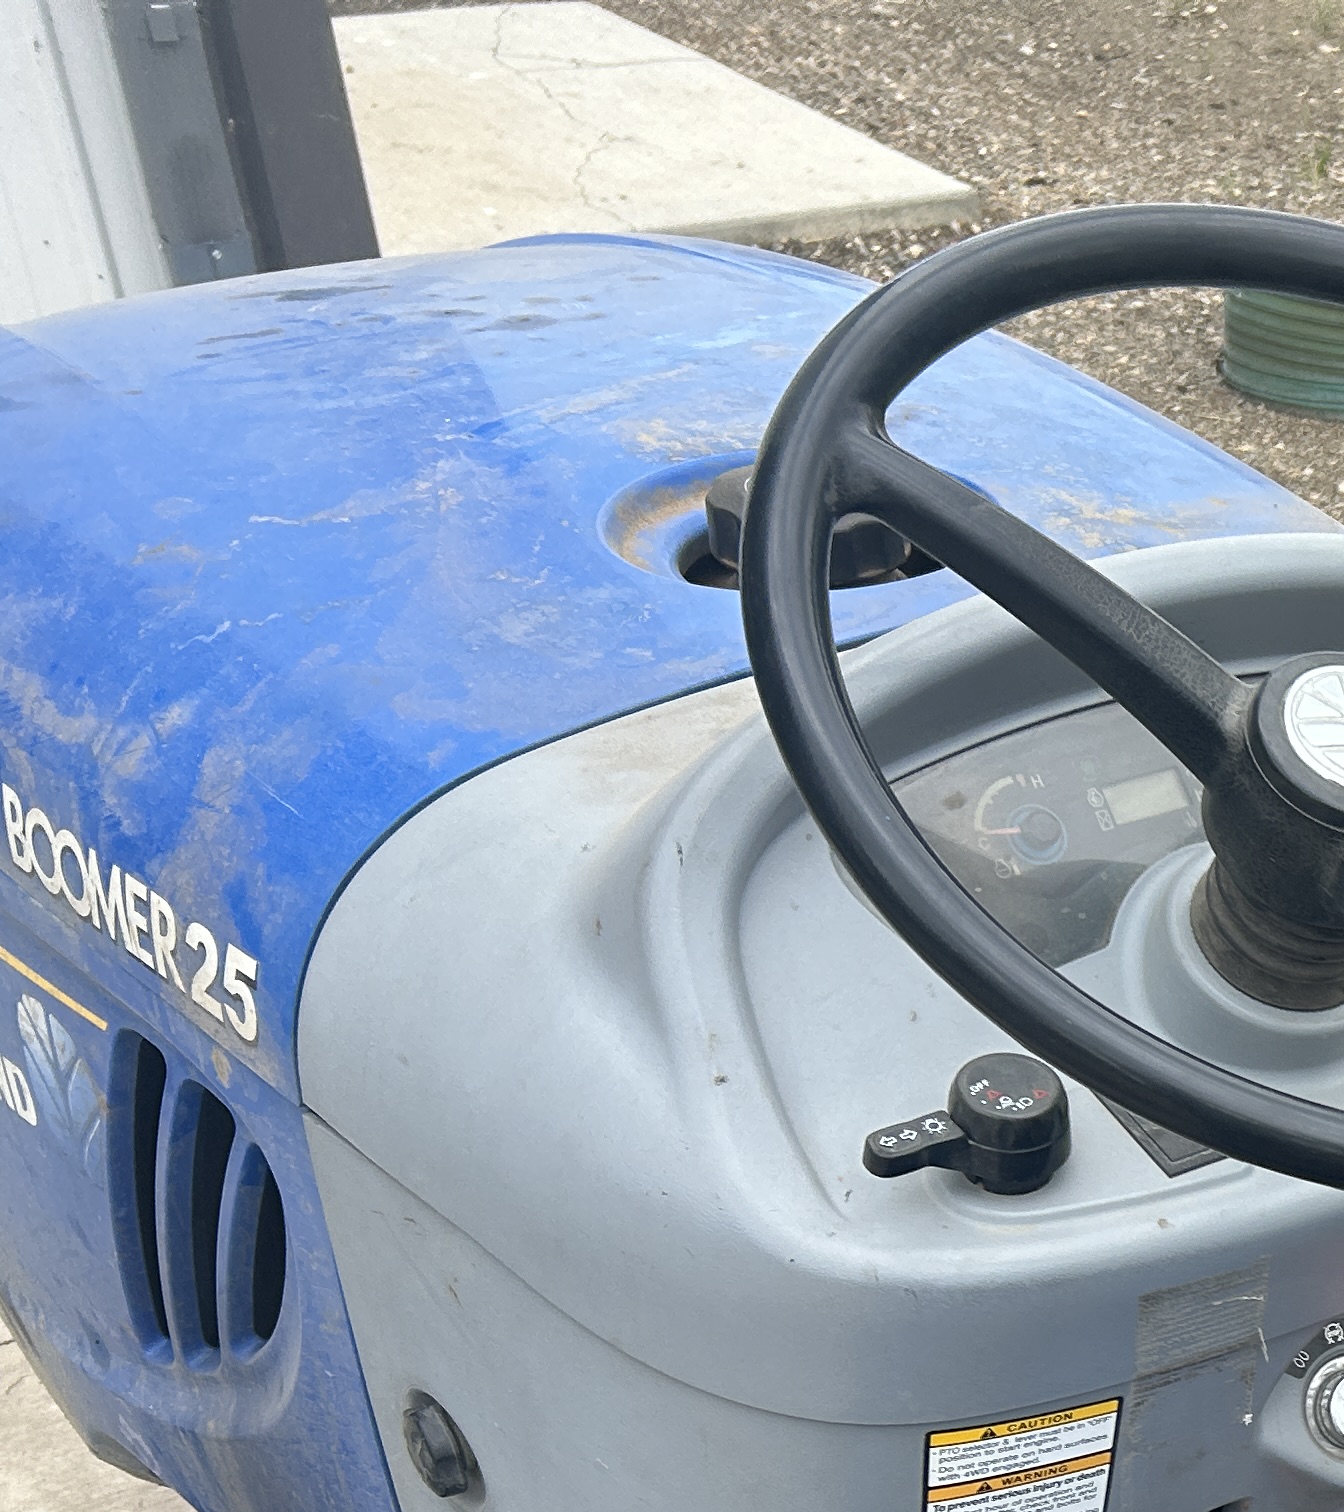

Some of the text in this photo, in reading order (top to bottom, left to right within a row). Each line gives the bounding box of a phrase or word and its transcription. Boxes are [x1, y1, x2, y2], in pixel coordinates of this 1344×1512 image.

[1031, 773, 1045, 788] H
[1, 783, 259, 1043] BOOMER 25
[969, 1079, 990, 1091] OFF
[1006, 1412, 1073, 1433] CAUTION
[939, 1452, 981, 1464] position
[998, 1444, 1020, 1453] start
[1023, 1437, 1060, 1448] engine.
[939, 1447, 960, 1456] PTO
[957, 1462, 975, 1470] not
[978, 1453, 1019, 1466] operate
[1038, 1444, 1062, 1454] hard
[1064, 1434, 1107, 1448] surfaces
[938, 1457, 1040, 1481] with 4WD engaged.
[1001, 1464, 1068, 1486] WARNING
[947, 1496, 989, 1511] prevent
[991, 1486, 1031, 1501] serious
[1033, 1479, 1062, 1492] injury
[1077, 1469, 1105, 1481] death
